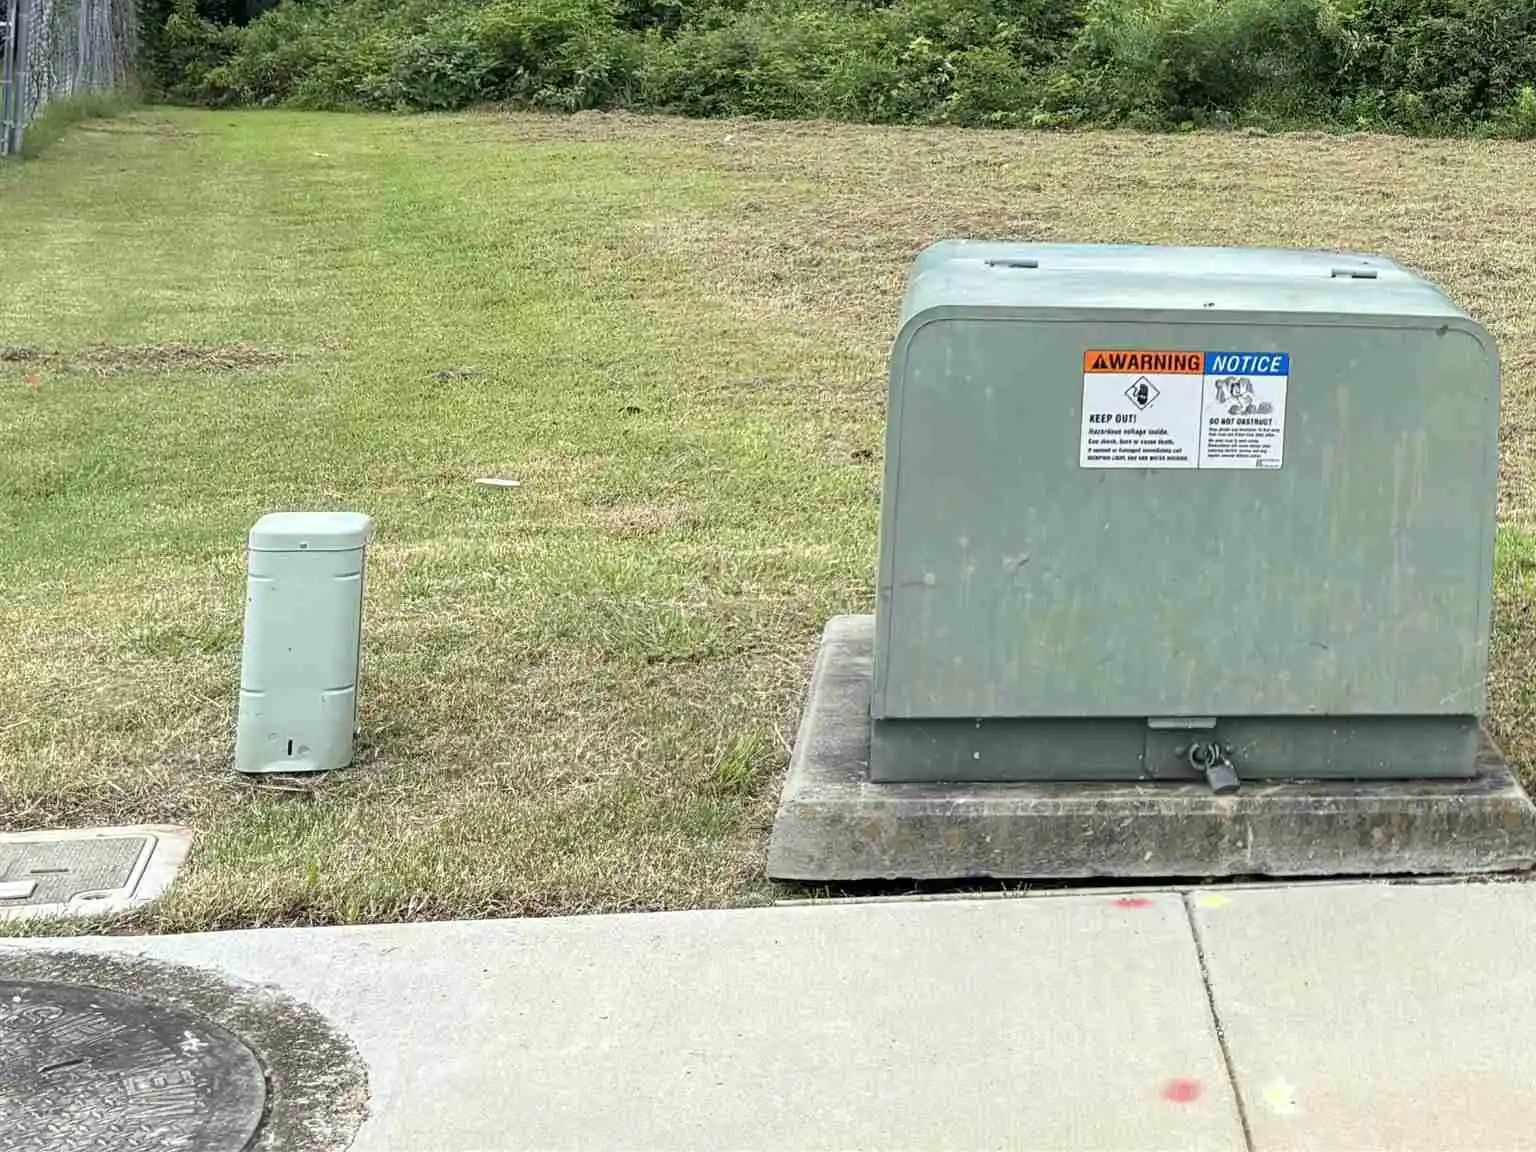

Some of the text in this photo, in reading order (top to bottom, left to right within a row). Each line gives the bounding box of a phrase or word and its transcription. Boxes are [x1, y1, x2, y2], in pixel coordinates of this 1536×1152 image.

[1109, 354, 1200, 371] WARNING
[1212, 355, 1282, 373] NOTICE
[1089, 414, 1137, 423] KEEP OUT!
